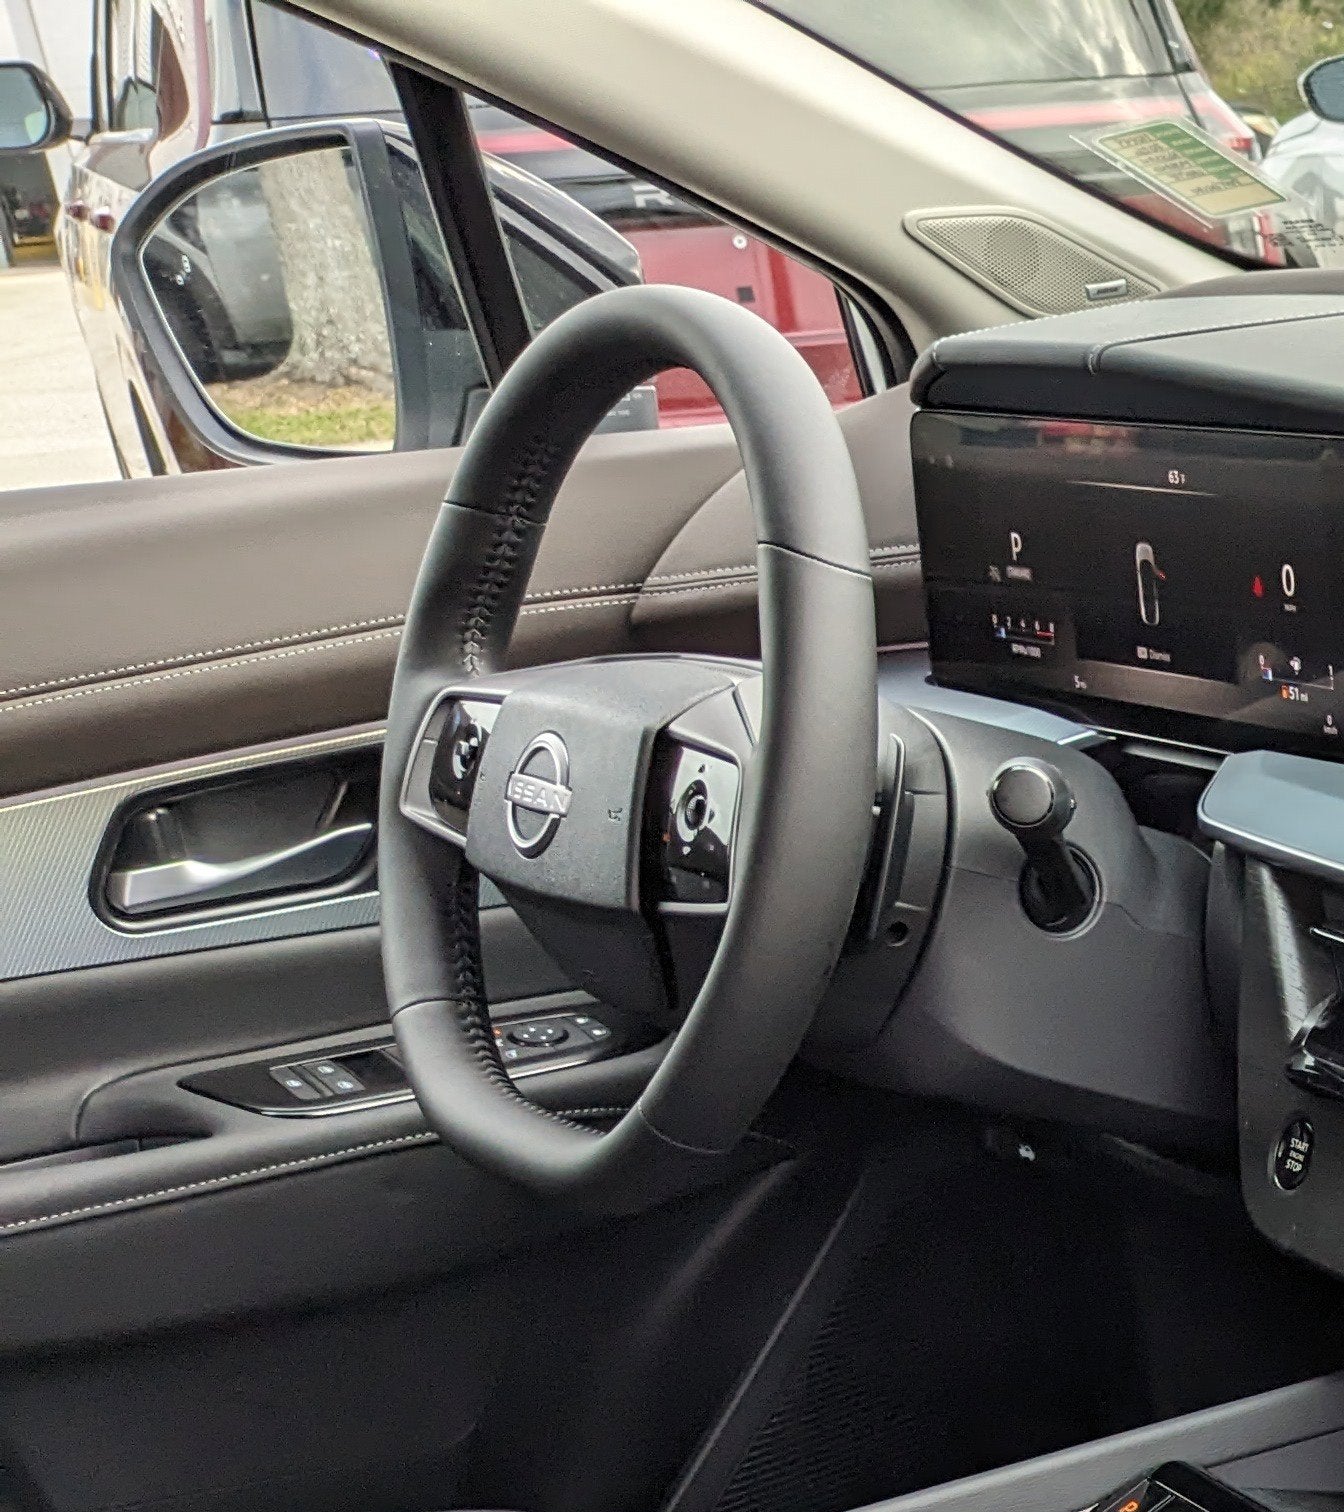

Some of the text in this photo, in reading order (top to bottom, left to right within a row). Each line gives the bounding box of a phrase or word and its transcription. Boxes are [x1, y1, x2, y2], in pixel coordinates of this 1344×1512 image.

[1010, 531, 1023, 562] P
[1282, 563, 1295, 598] 0
[1290, 1137, 1310, 1152] START
[1284, 1158, 1303, 1172] STOP
